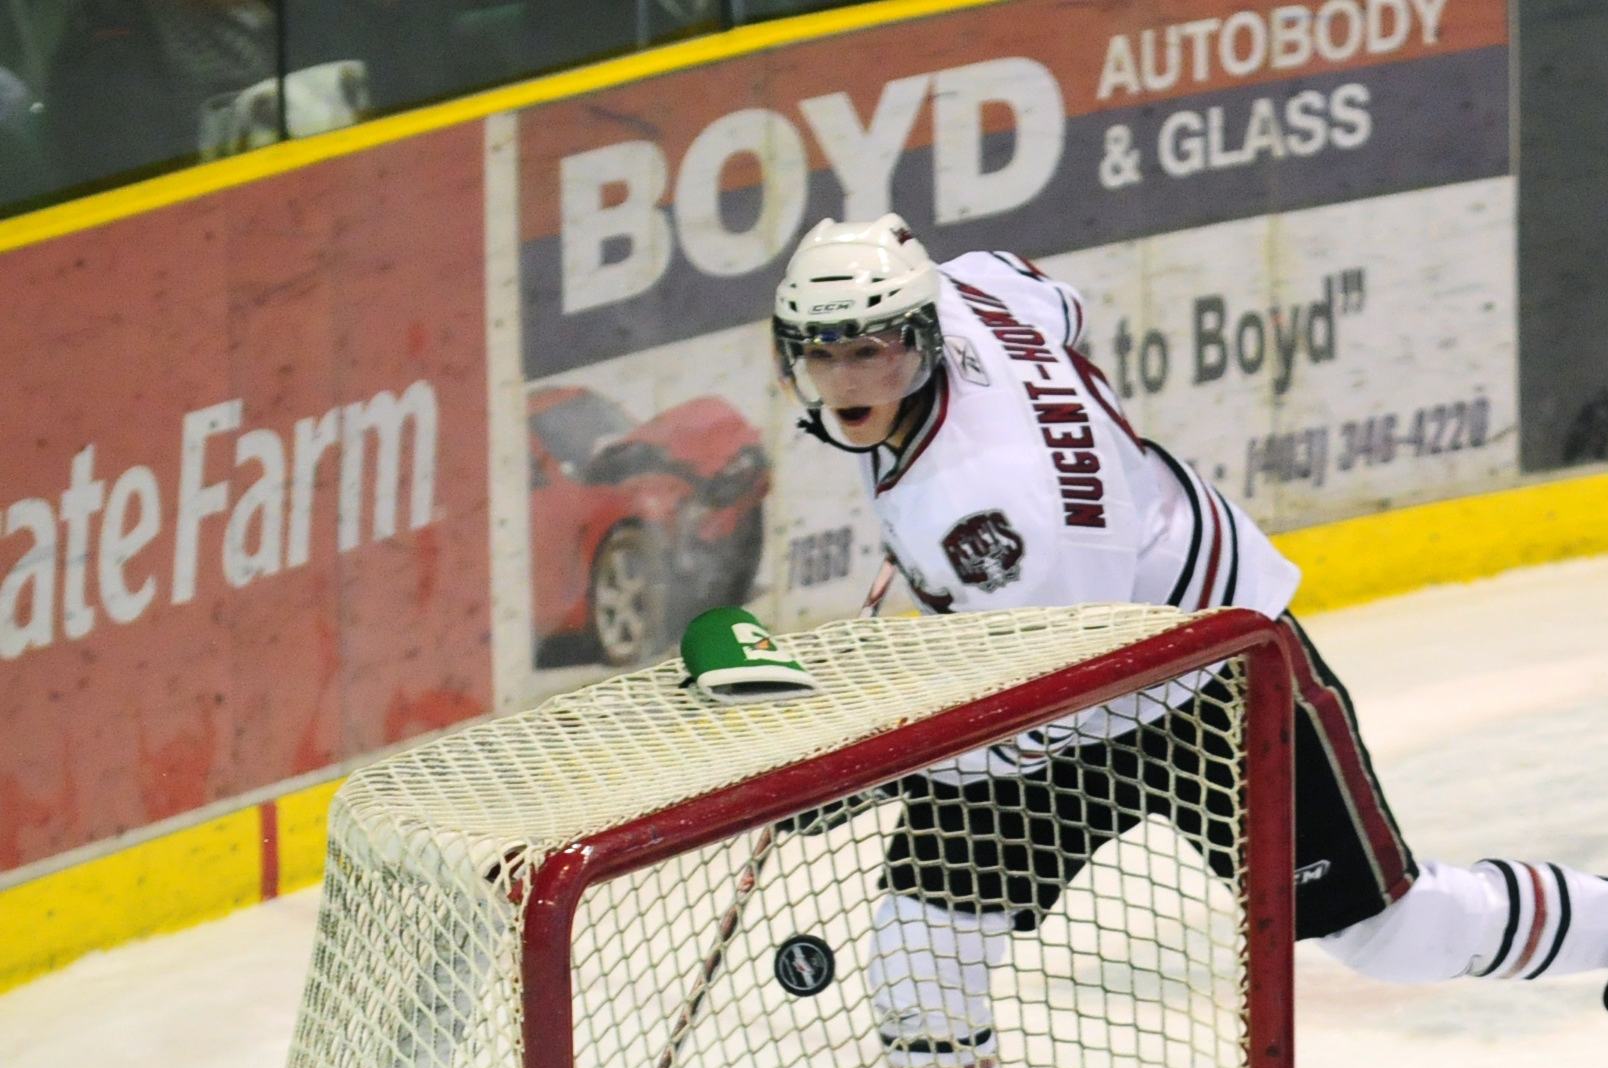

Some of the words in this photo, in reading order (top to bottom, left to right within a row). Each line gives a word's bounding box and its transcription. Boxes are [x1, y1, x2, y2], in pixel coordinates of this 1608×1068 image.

[1096, 0, 1449, 99] AUTOBODY
[559, 56, 1065, 315] BOYD
[1100, 125, 1142, 189] &
[1157, 83, 1373, 177] GLASS
[811, 302, 850, 313] CCM
[1113, 316, 1169, 399] to
